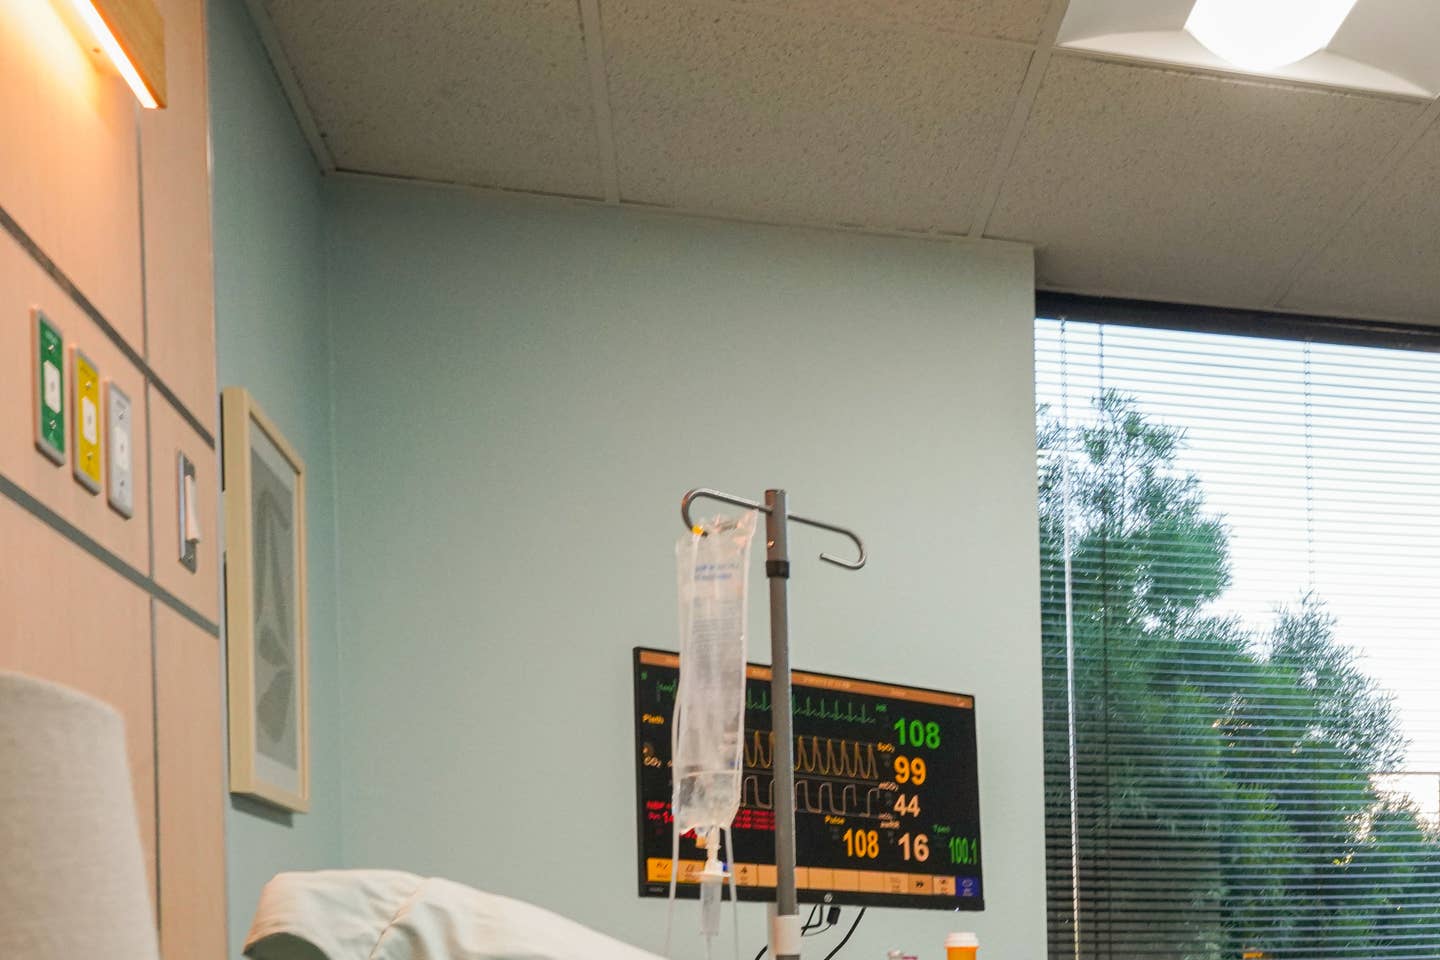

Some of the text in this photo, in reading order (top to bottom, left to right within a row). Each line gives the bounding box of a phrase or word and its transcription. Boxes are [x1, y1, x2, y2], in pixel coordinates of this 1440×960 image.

[893, 717, 940, 749] 108
[894, 755, 926, 786] 99
[893, 793, 921, 818] 44
[842, 828, 879, 859] 108
[898, 832, 929, 863] 16
[948, 836, 978, 865] 100.1
